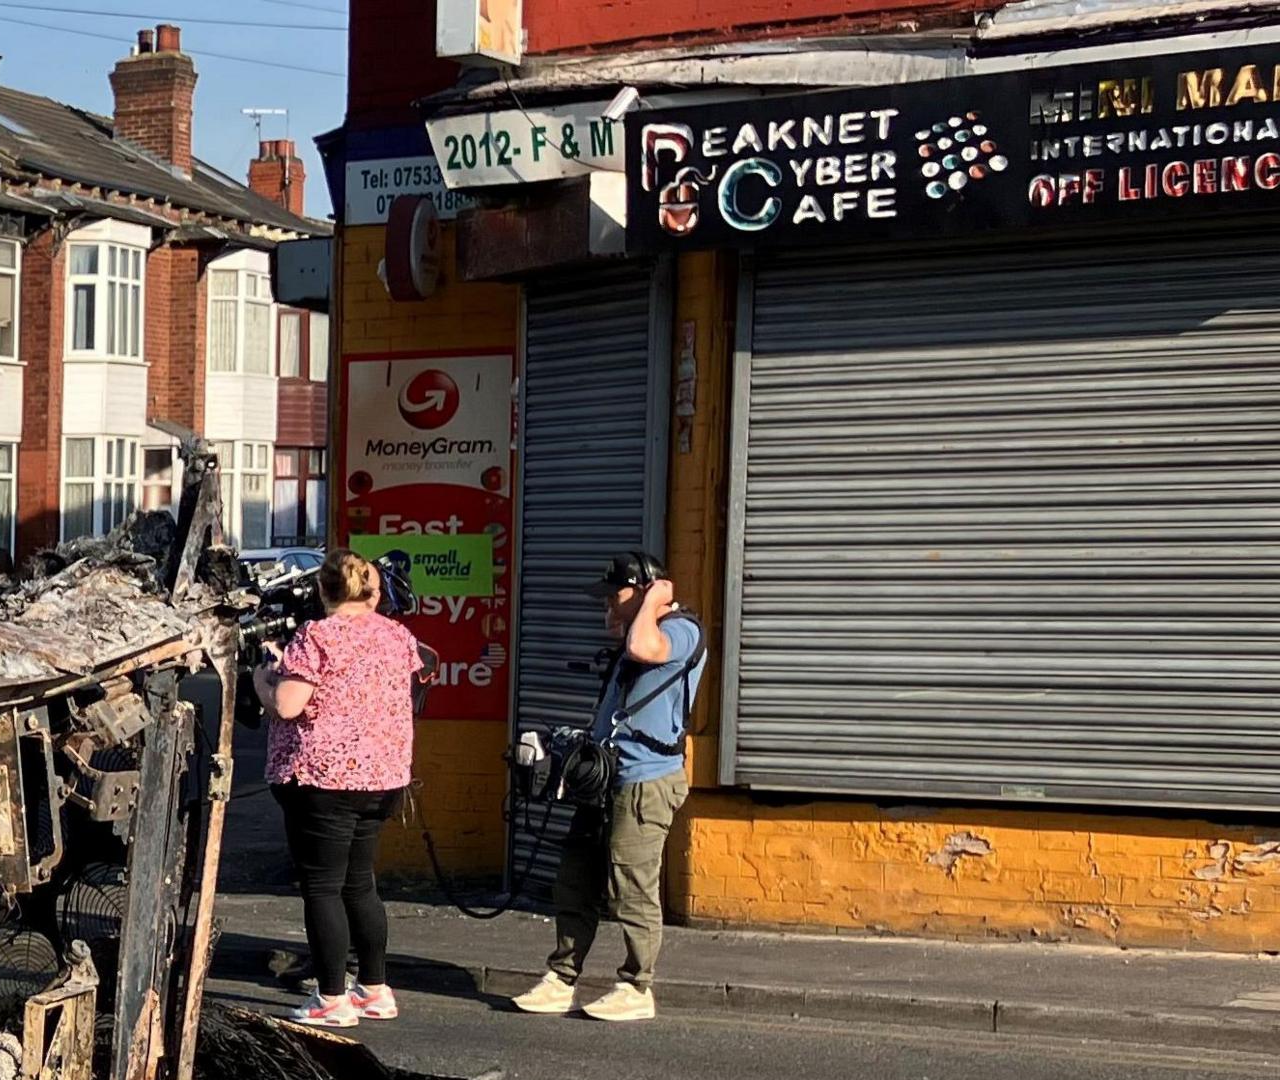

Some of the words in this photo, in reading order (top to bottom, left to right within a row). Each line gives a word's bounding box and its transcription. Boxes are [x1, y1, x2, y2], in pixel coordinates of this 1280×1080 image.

[1176, 64, 1280, 111] MA
[531, 126, 546, 162] F
[560, 122, 581, 160] &
[590, 119, 614, 157] M
[1030, 117, 1280, 161] INTERNATIONA
[361, 167, 388, 189] Tel:
[1028, 168, 1104, 208] OFF
[1118, 152, 1280, 202] LICENC
[365, 437, 493, 460] MoneyGram
[382, 461, 422, 474] money
[424, 459, 474, 471] transfer
[413, 549, 458, 565] small
[425, 560, 472, 577] world
